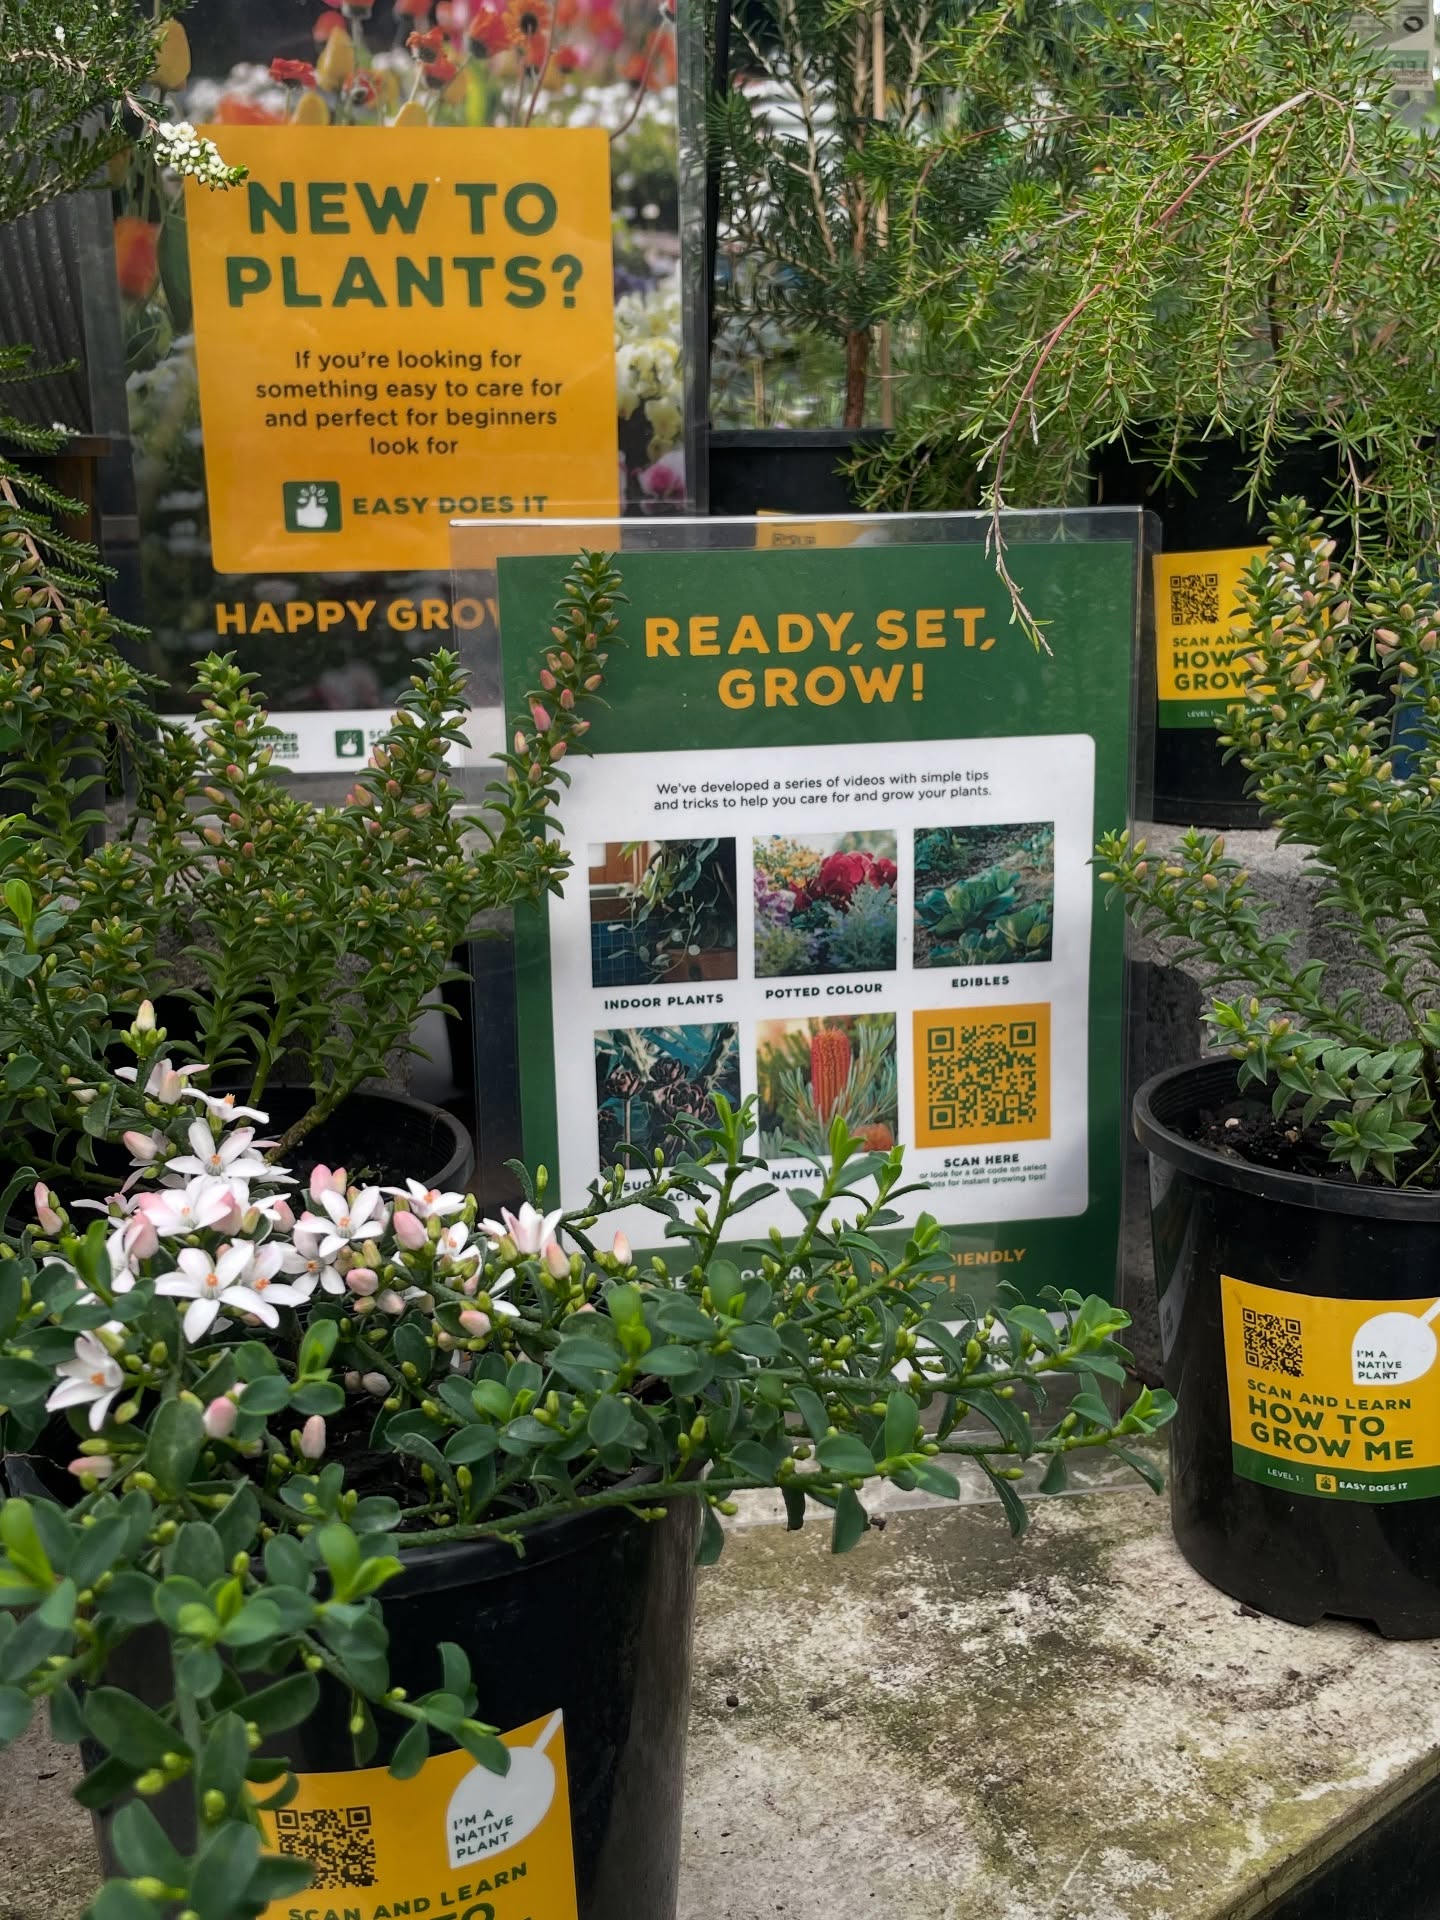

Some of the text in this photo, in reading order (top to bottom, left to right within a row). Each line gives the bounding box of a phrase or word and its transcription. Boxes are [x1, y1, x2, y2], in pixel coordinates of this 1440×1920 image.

[247, 181, 557, 236] NEW TO
[225, 254, 583, 308] PLANTS?
[295, 350, 311, 369] If
[397, 350, 482, 371] looking
[490, 350, 522, 368] for
[256, 378, 563, 401] something easy to care for
[265, 407, 557, 430] and perfect for beginners
[370, 436, 458, 455] look for
[353, 496, 549, 516] EASY DOES IT
[215, 599, 376, 635] HAPPY
[645, 608, 997, 657] READY, SET,
[1172, 636, 1209, 647] SCAN
[1173, 650, 1236, 669] HOW
[718, 663, 924, 710] GROW!
[701, 779, 769, 793] developed
[773, 781, 781, 790] a
[785, 778, 822, 789] series
[826, 776, 840, 787] of
[844, 775, 886, 787] videos
[889, 773, 917, 784] with
[921, 770, 962, 783] simple
[966, 770, 989, 782] tips
[654, 785, 992, 810] and tricks to help you care for and grow your plants.
[765, 982, 883, 999] POTTED COLOUR
[951, 975, 1010, 988] EDIBLES
[604, 993, 724, 1010] INDOOR PLANTS
[930, 1170, 948, 1178] look
[951, 1169, 962, 1177] for
[987, 1166, 1008, 1175] code
[1022, 1163, 1047, 1172] select
[944, 1153, 1020, 1167] SCAN HERE
[771, 1168, 821, 1181] NATIVE
[948, 1178, 959, 1186] for
[961, 1176, 990, 1185] instant
[992, 1174, 1026, 1185] growing
[1357, 1360, 1402, 1369] NATIVE
[1379, 1350, 1387, 1358] A
[1357, 1371, 1398, 1380] PLANT
[1247, 1378, 1411, 1411] SCAN AND LEARN
[1248, 1395, 1385, 1437] HOW TO
[1250, 1421, 1414, 1461] GROW ME
[1267, 1467, 1294, 1481] LEVEL
[1339, 1481, 1366, 1491] EASY
[1368, 1483, 1396, 1492] DOES
[1398, 1482, 1408, 1490] IT
[483, 1808, 494, 1819] A
[455, 1814, 514, 1844] NATIVE
[456, 1831, 509, 1859] PLANT
[373, 1896, 430, 1920] AND
[441, 1862, 527, 1907] LEARN
